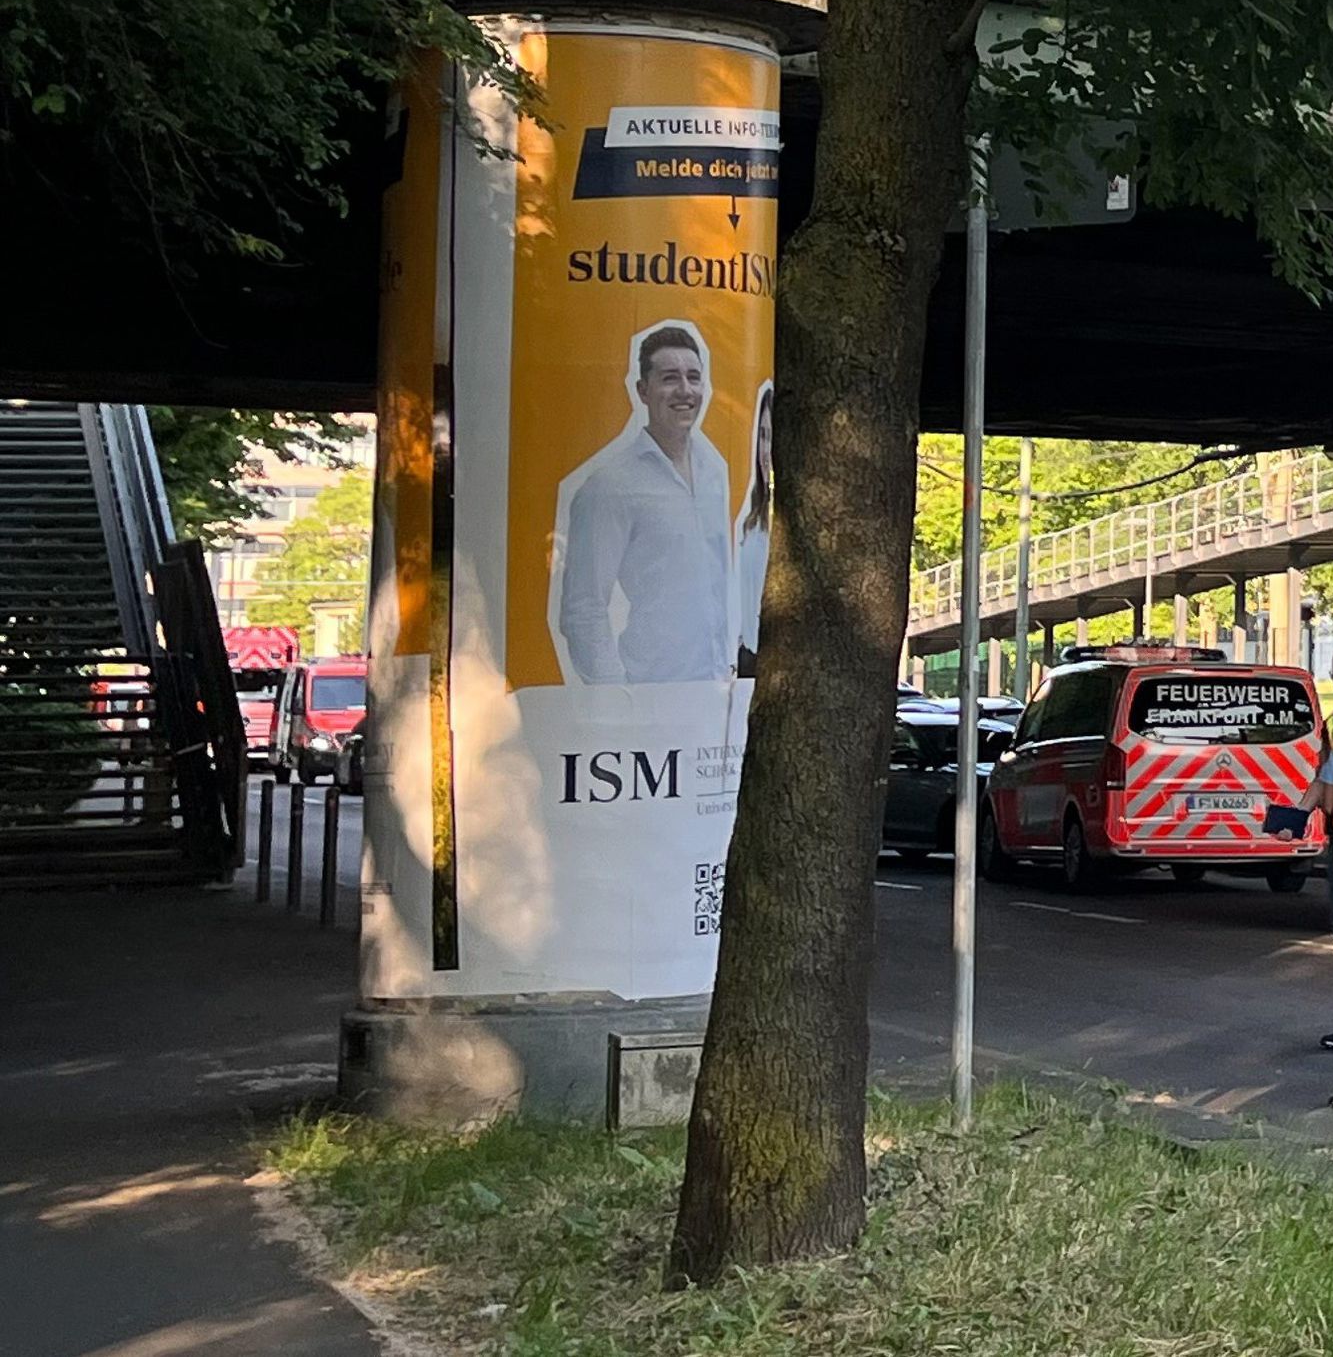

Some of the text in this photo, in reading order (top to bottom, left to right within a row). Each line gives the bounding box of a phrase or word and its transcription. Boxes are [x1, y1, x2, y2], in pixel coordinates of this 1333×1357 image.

[625, 119, 722, 135] AKTUELLE
[635, 158, 703, 178] Melde
[709, 159, 742, 179] dich
[1156, 684, 1289, 704] FEUERWEHR
[1264, 710, 1298, 725] a.M.
[559, 749, 682, 803] ISM
